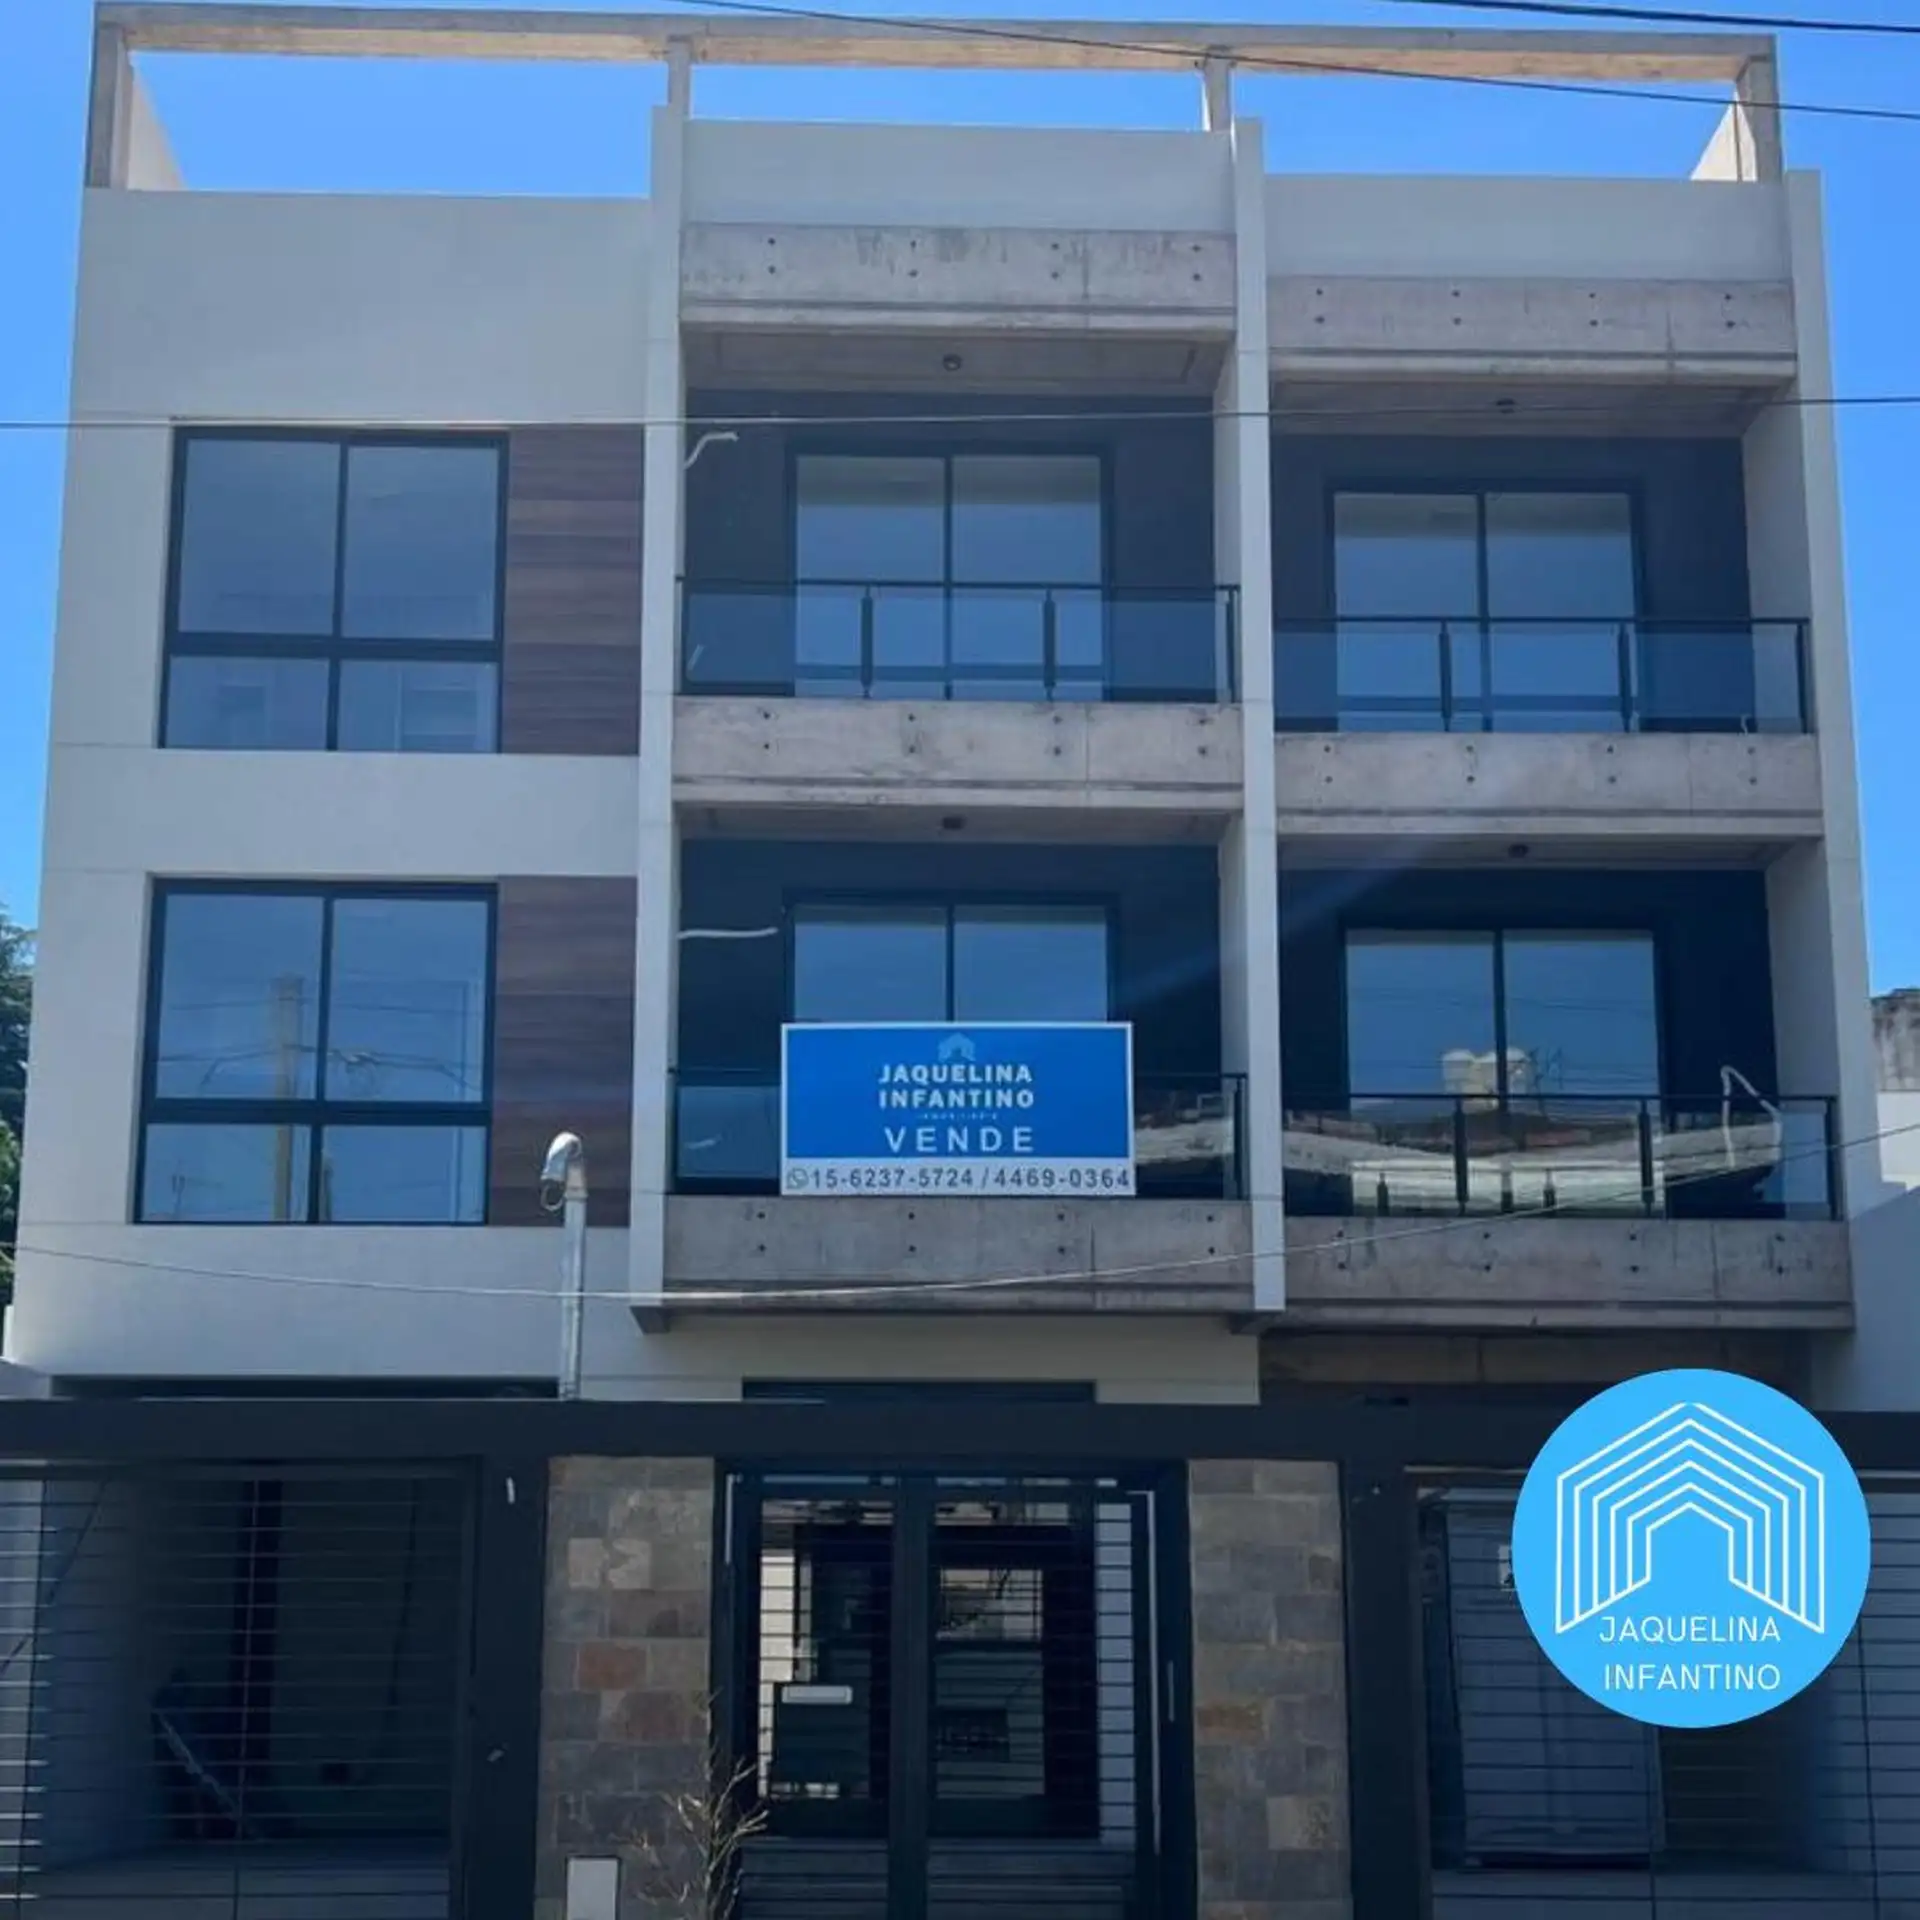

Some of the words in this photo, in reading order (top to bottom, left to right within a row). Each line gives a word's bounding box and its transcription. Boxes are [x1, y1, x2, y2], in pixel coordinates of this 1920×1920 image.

[878, 1064, 1033, 1084] JAQUELINA
[879, 1089, 1034, 1109] INFANTINO
[884, 1127, 1034, 1152] VENDE
[812, 1168, 972, 1188] 15-6237-5724
